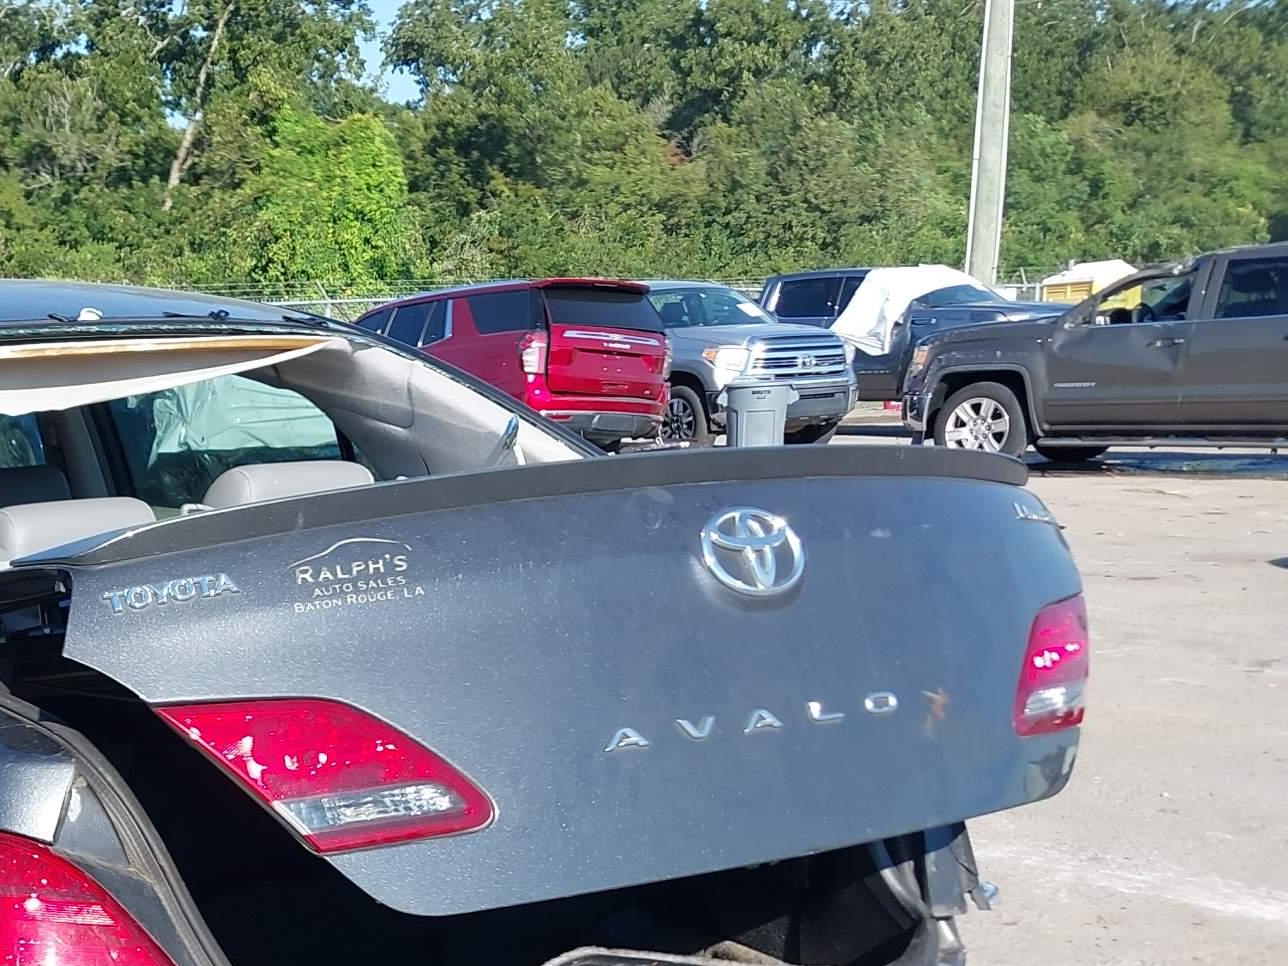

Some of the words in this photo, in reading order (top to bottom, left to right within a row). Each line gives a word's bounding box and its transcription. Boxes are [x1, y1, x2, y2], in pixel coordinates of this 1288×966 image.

[295, 554, 409, 585] RALPH'S
[102, 573, 242, 615] TOYOTA
[293, 598, 343, 614] BATON
[403, 586, 426, 599] LA
[312, 582, 354, 599] AUTO
[357, 576, 407, 591] SALES
